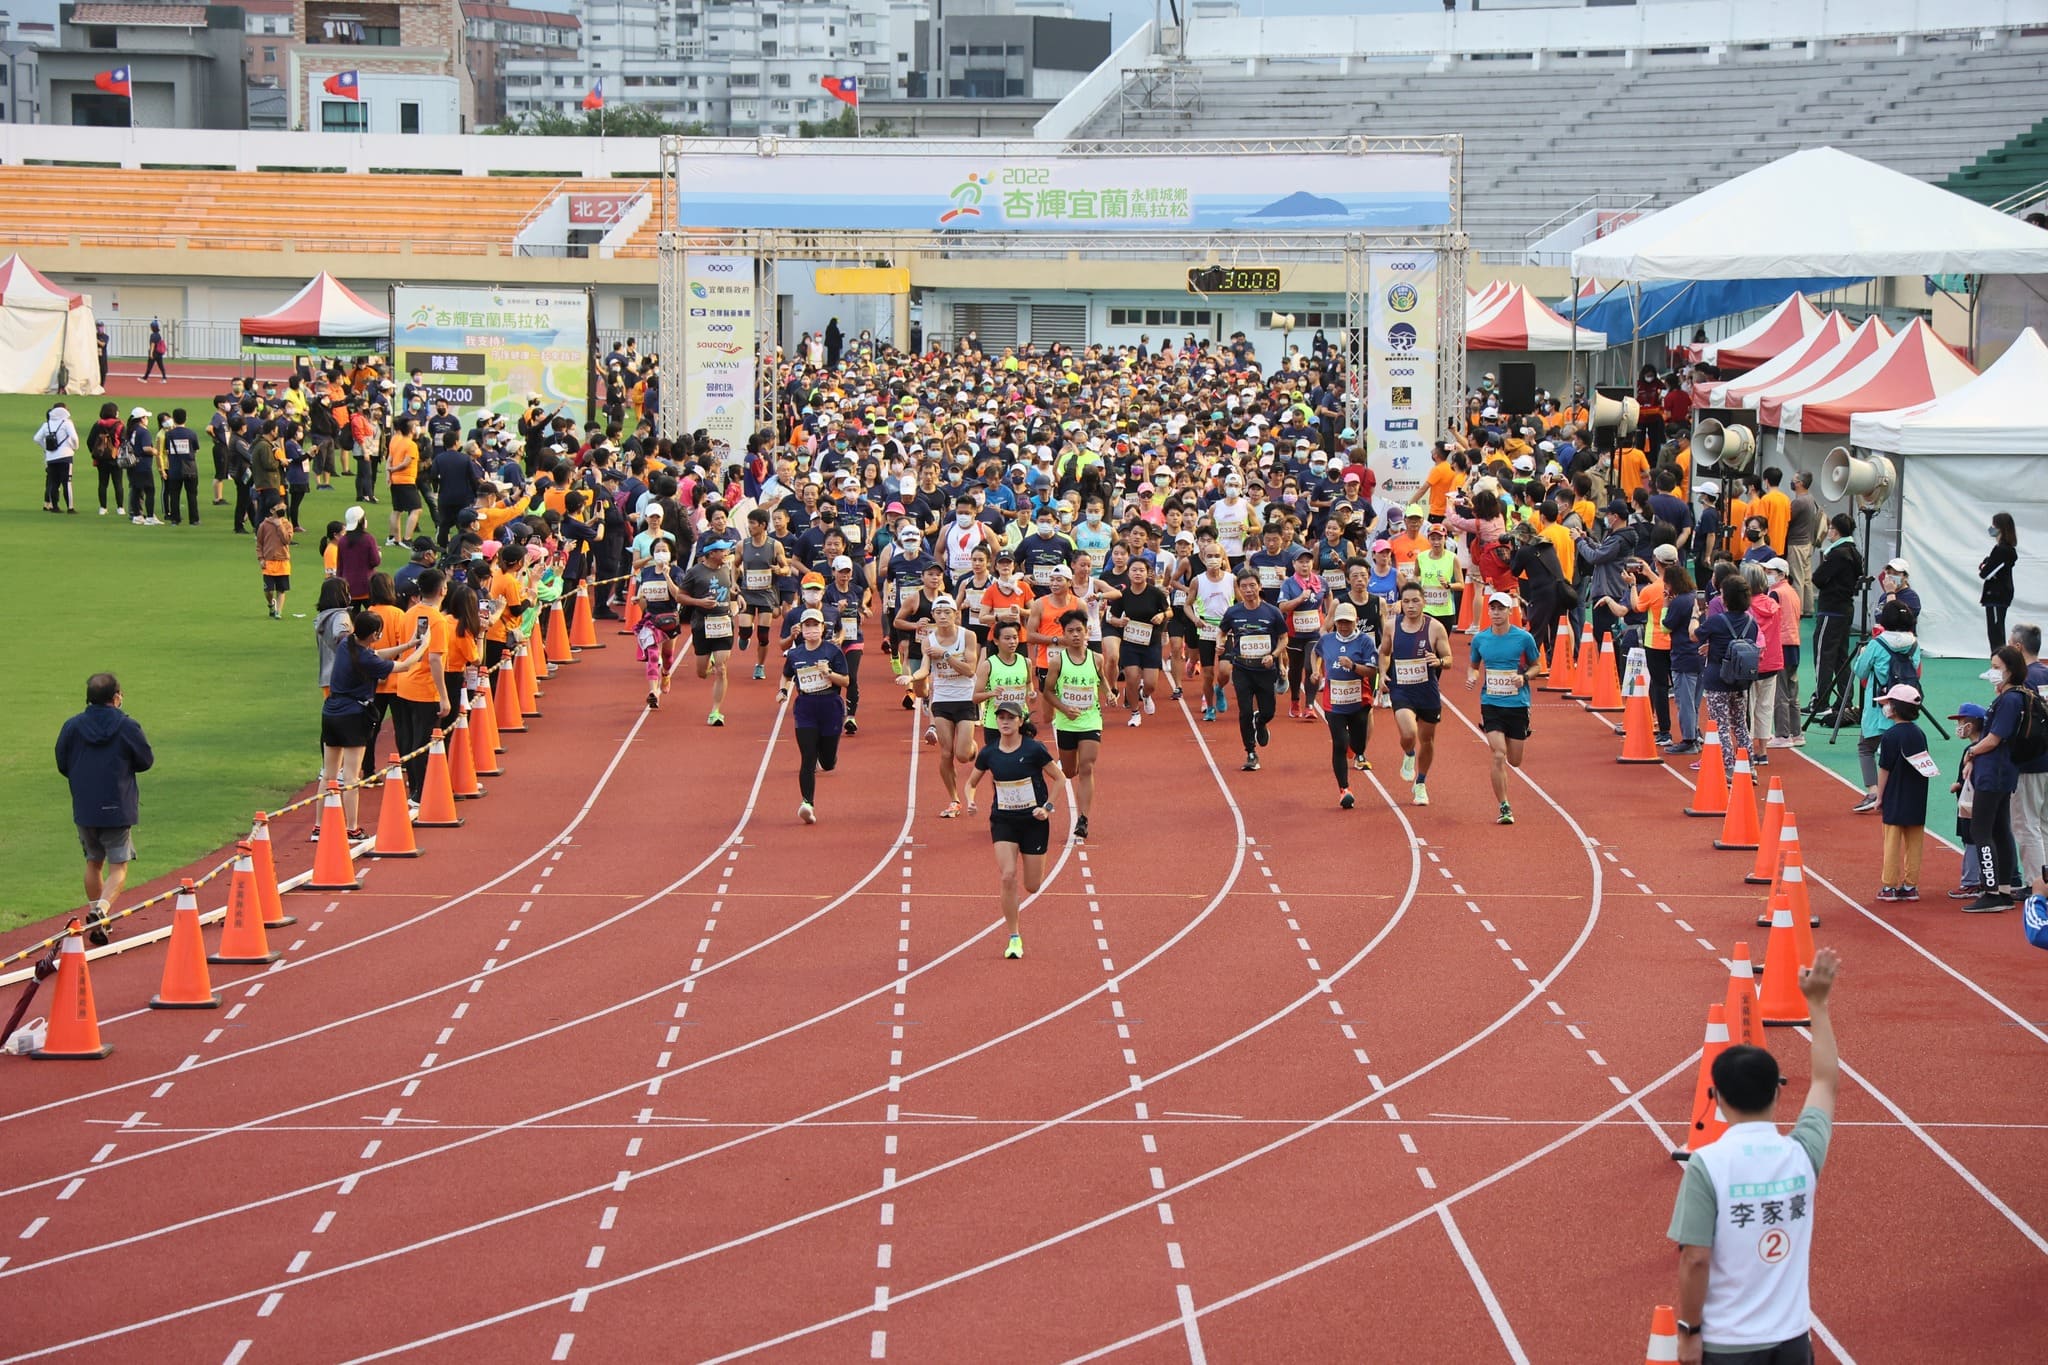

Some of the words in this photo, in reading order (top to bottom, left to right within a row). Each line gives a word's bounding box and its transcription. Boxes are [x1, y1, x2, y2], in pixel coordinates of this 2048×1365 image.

[1003, 168, 1049, 184] 2022
[1131, 188, 1188, 201] 永續城鄉
[1003, 188, 1127, 219] 杏輝宜蘭
[1131, 202, 1189, 218] 馬拉松
[435, 312, 550, 329] 杏輝宜蘭馬拉松
[696, 341, 734, 350] saucony
[1325, 574, 1345, 583] 8096
[1063, 691, 1093, 701] C8041
[1981, 846, 1996, 887] adidas
[1730, 1193, 1807, 1228] 李家豪
[1766, 1233, 1782, 1258] 2
